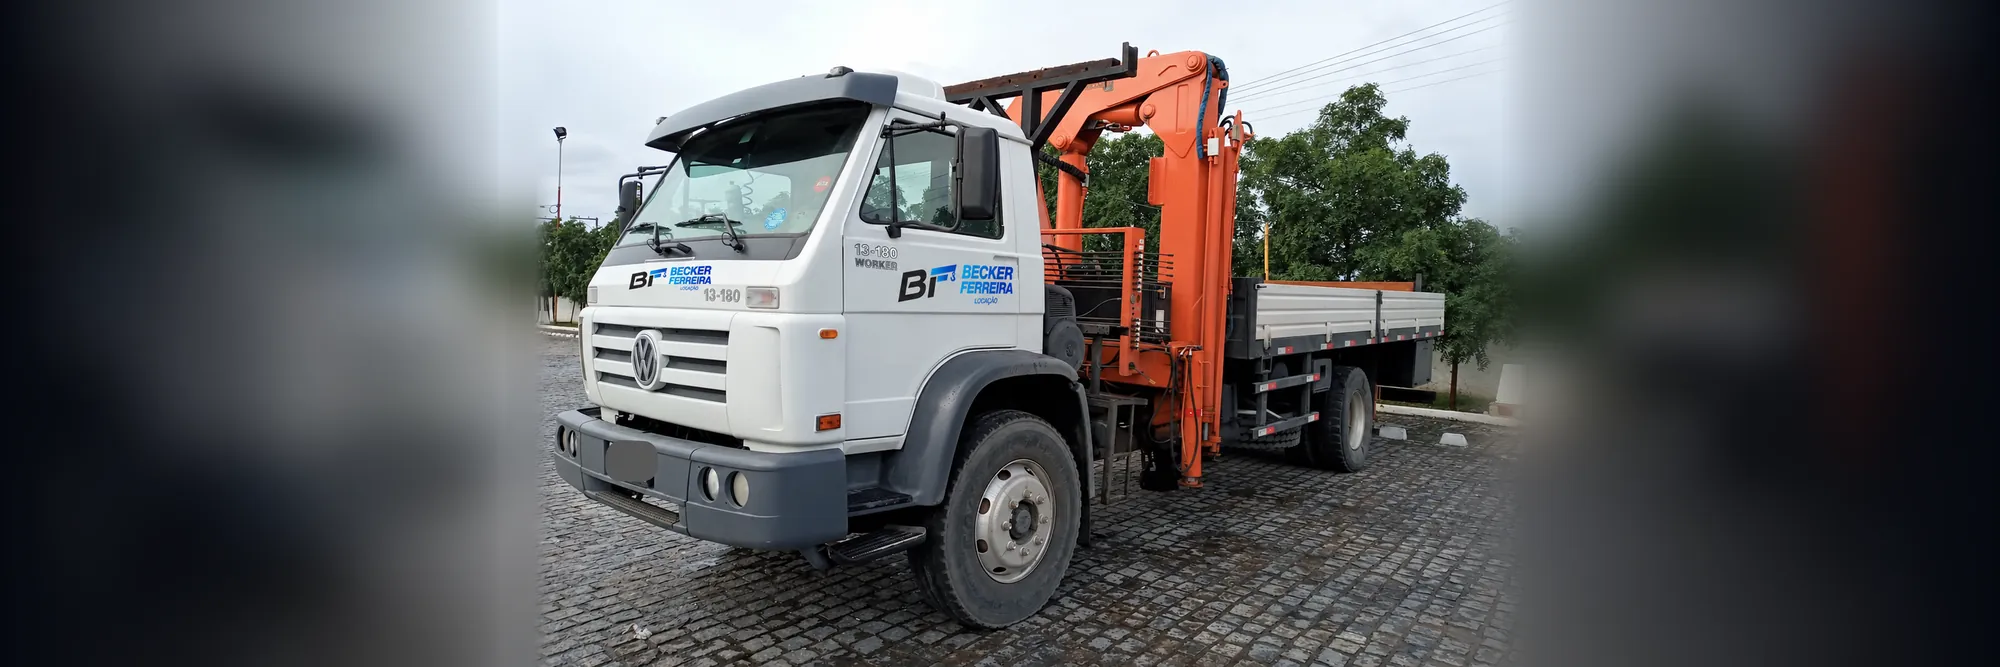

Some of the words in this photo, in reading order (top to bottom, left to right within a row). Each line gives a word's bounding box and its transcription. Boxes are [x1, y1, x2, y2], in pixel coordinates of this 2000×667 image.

[854, 243, 898, 259] 13-180
[670, 265, 712, 276] BECKER
[855, 258, 898, 271] WORKER
[961, 264, 1014, 280] BECKER
[668, 276, 712, 285] FERREIRA
[959, 281, 1013, 294] FERREIRA
[704, 288, 741, 303] 13-180
[633, 335, 657, 386] VW
